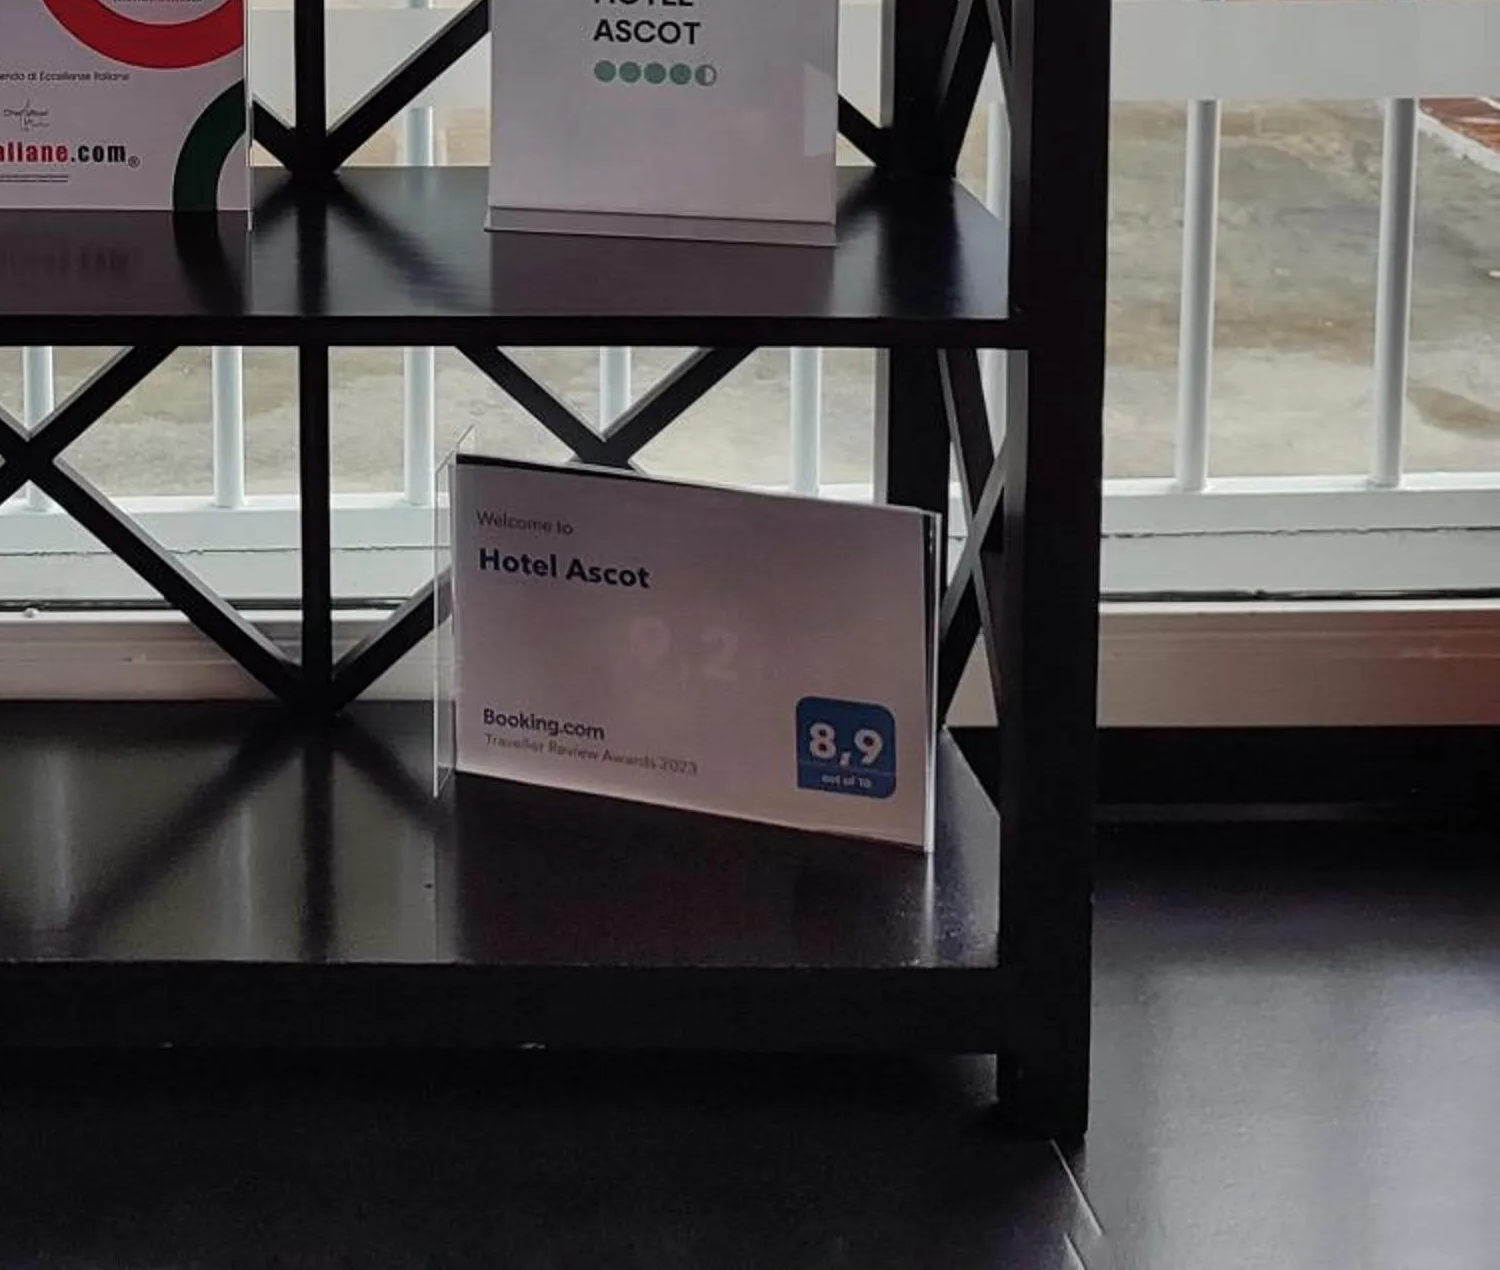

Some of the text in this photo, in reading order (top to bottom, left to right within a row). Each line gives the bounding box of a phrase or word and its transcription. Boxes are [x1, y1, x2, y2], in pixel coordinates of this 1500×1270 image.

[593, 19, 701, 45] ASCOT
[476, 509, 574, 536] Welcome to
[478, 547, 651, 589] Hotel Ascot
[483, 708, 605, 740] Booking.com
[484, 733, 698, 776] Traveller Review Awards 2023
[809, 721, 883, 767] 8,9
